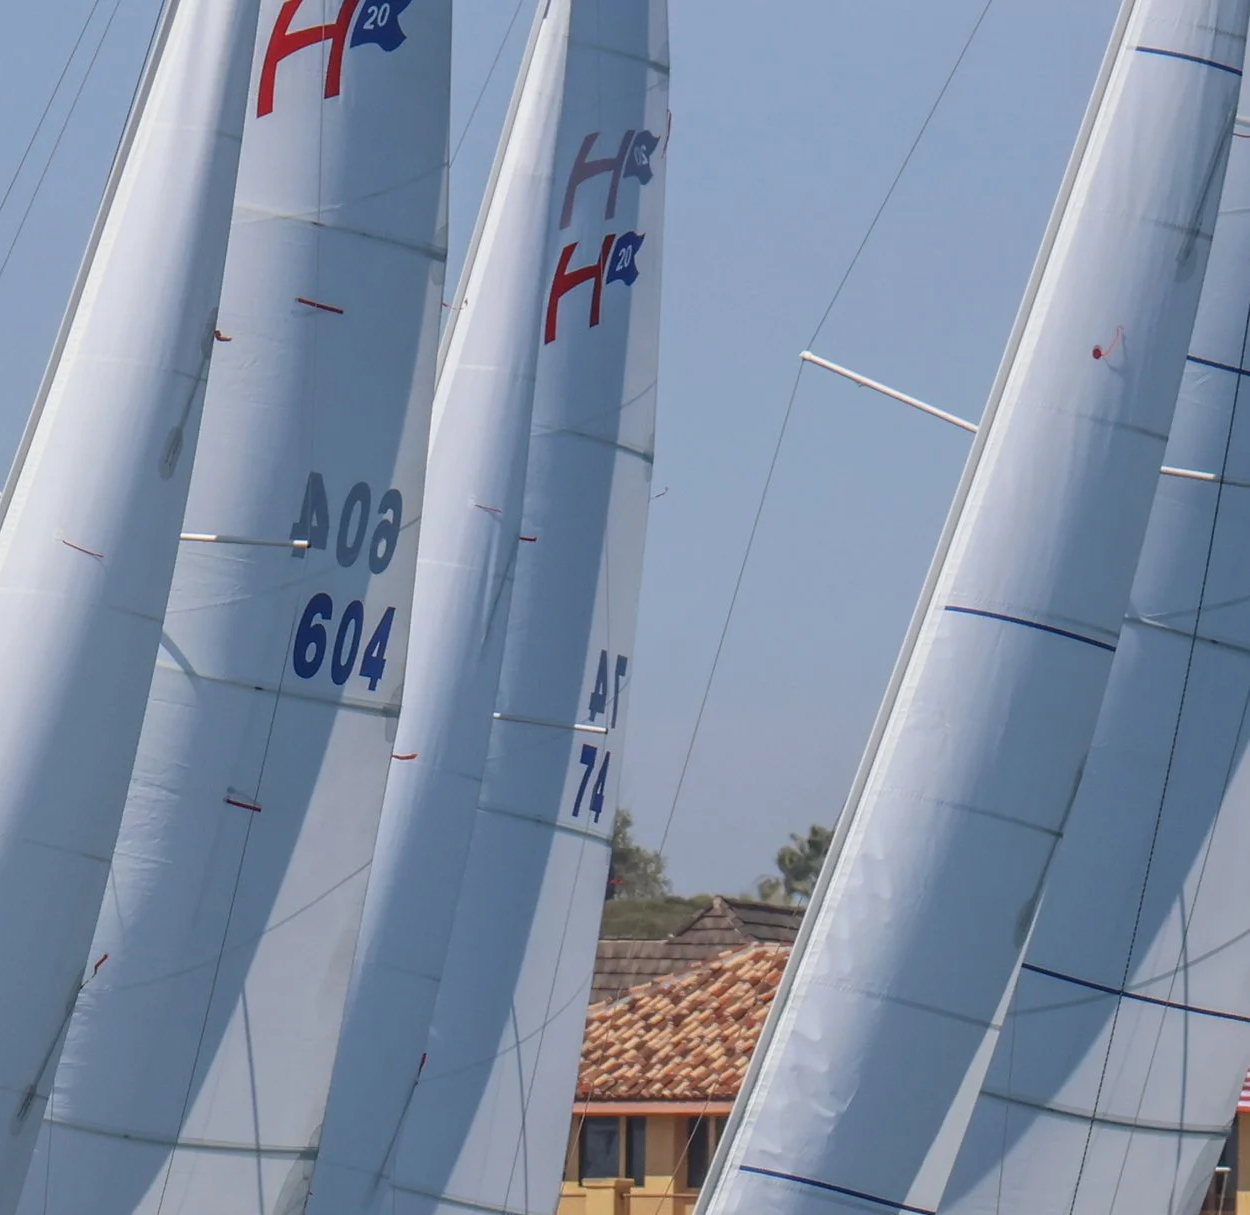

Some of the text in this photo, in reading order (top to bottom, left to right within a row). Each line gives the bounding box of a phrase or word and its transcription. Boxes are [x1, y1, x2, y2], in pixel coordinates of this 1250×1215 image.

[256, 0, 391, 119] H 20
[544, 233, 633, 345] H 20
[293, 593, 396, 692] 604
[572, 743, 611, 824] 74
